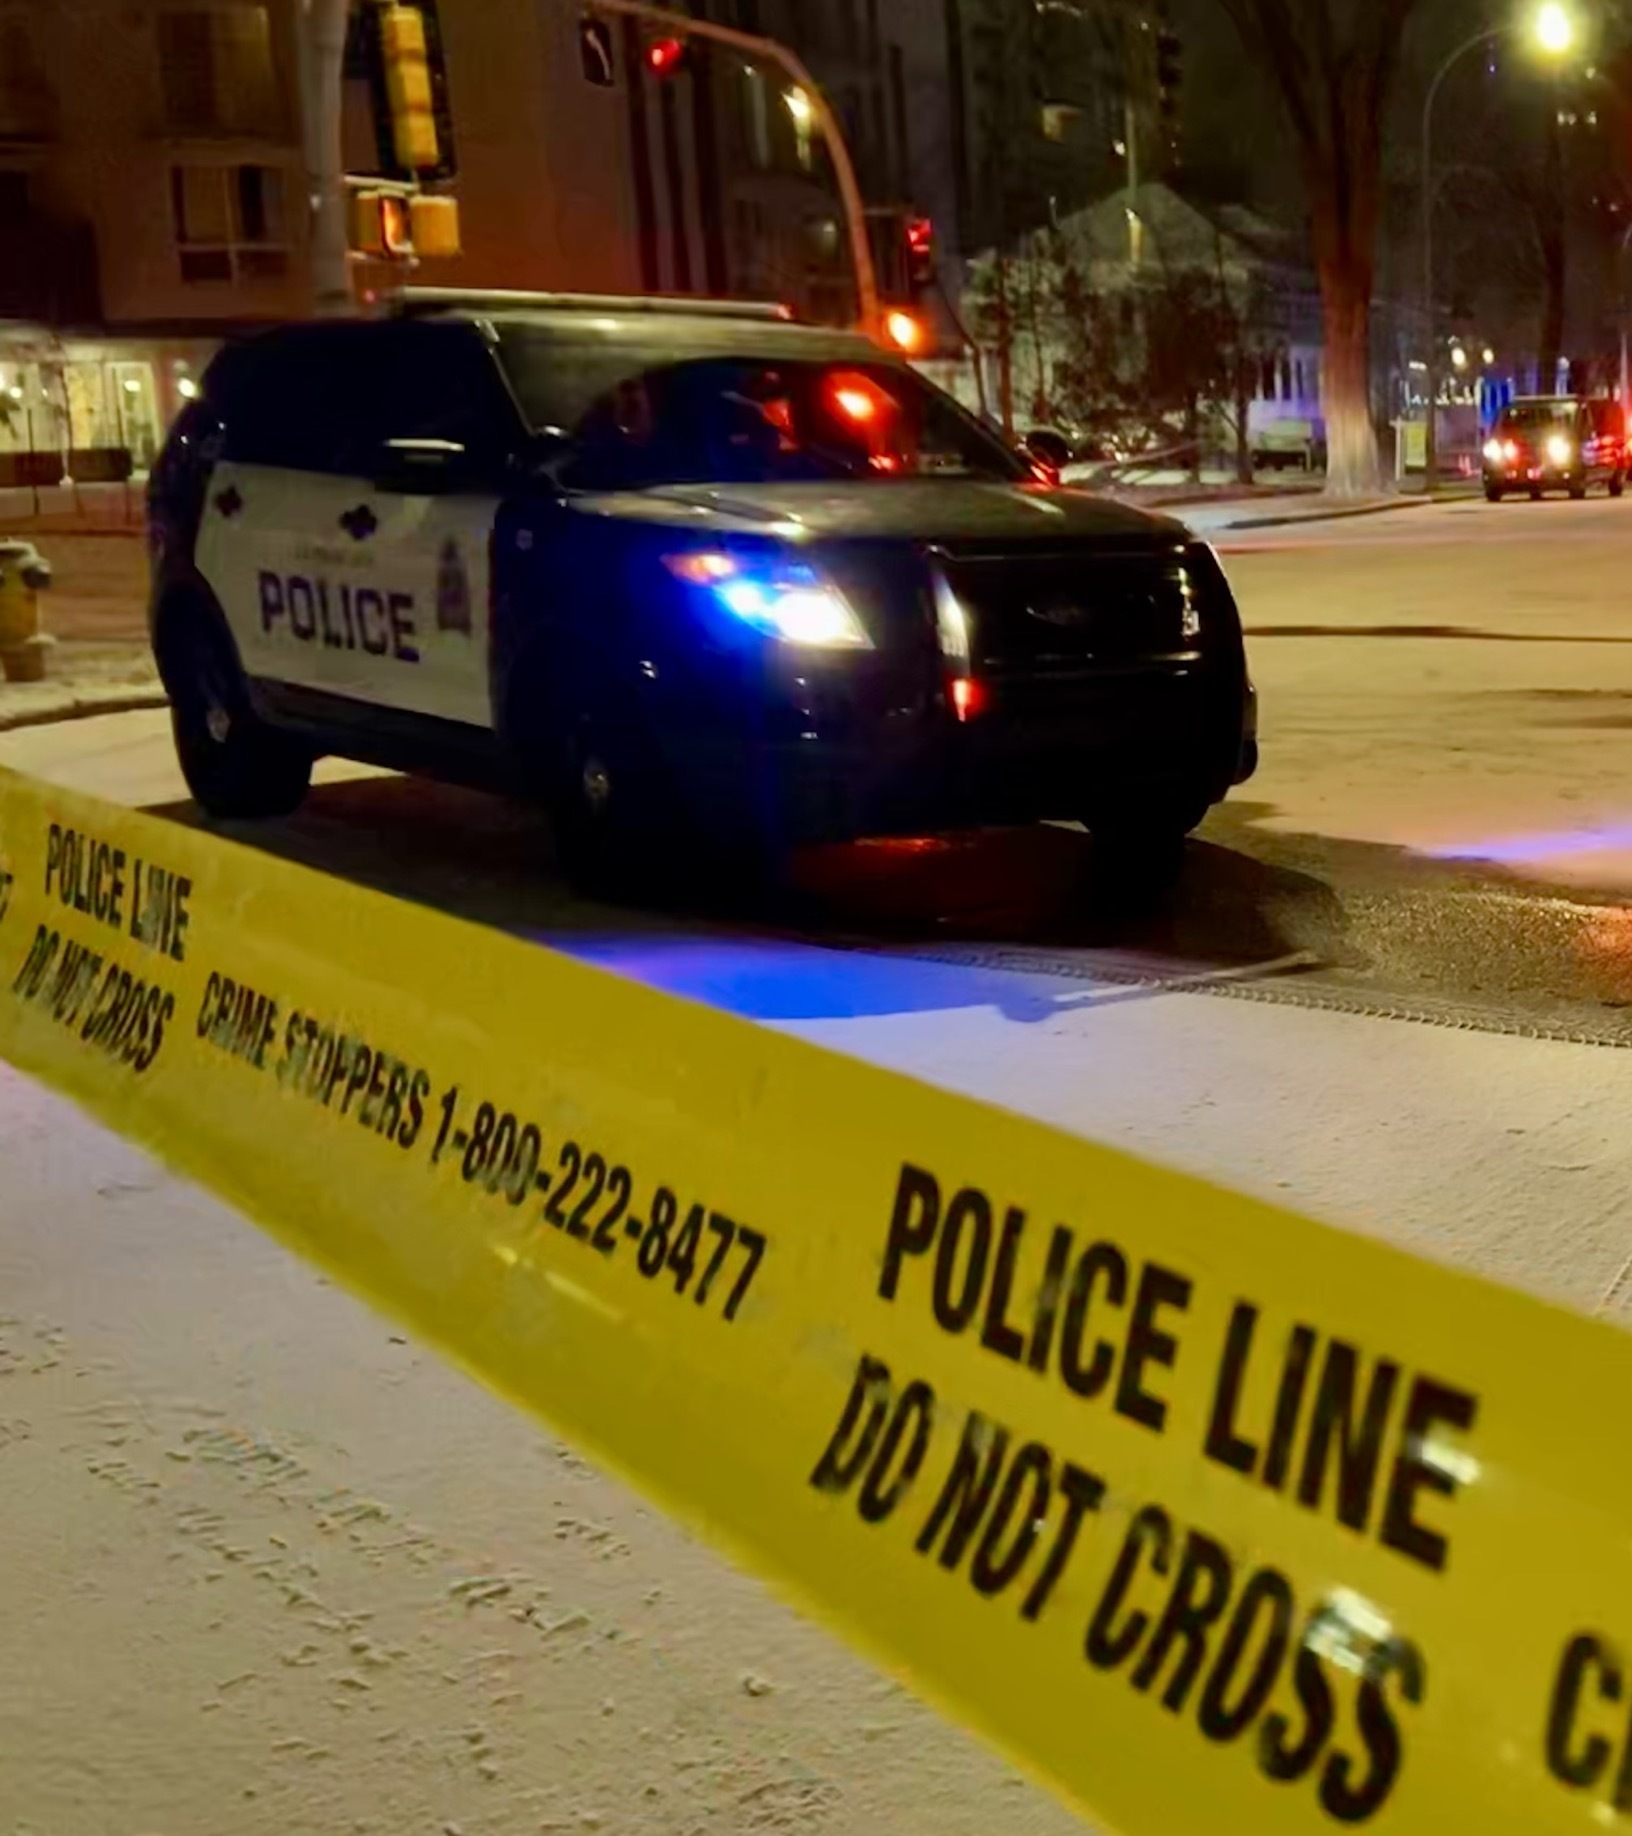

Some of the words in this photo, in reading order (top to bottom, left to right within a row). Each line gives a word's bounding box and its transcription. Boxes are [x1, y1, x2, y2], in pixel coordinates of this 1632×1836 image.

[258, 570, 420, 663] POLICE
[12, 924, 60, 999] DO
[81, 963, 175, 1073] CROSS
[45, 823, 126, 930] POLICE
[130, 858, 193, 962] LINE
[197, 970, 277, 1071] CRIME
[276, 1010, 430, 1150] STOPPERS
[431, 1083, 767, 1322] 1-800-222-8477
[878, 1160, 1193, 1433] POLICE
[1203, 1298, 1479, 1574] LINE
[809, 1352, 937, 1524] DO
[914, 1410, 1107, 1622] NOT
[1085, 1504, 1427, 1825] CROSS
